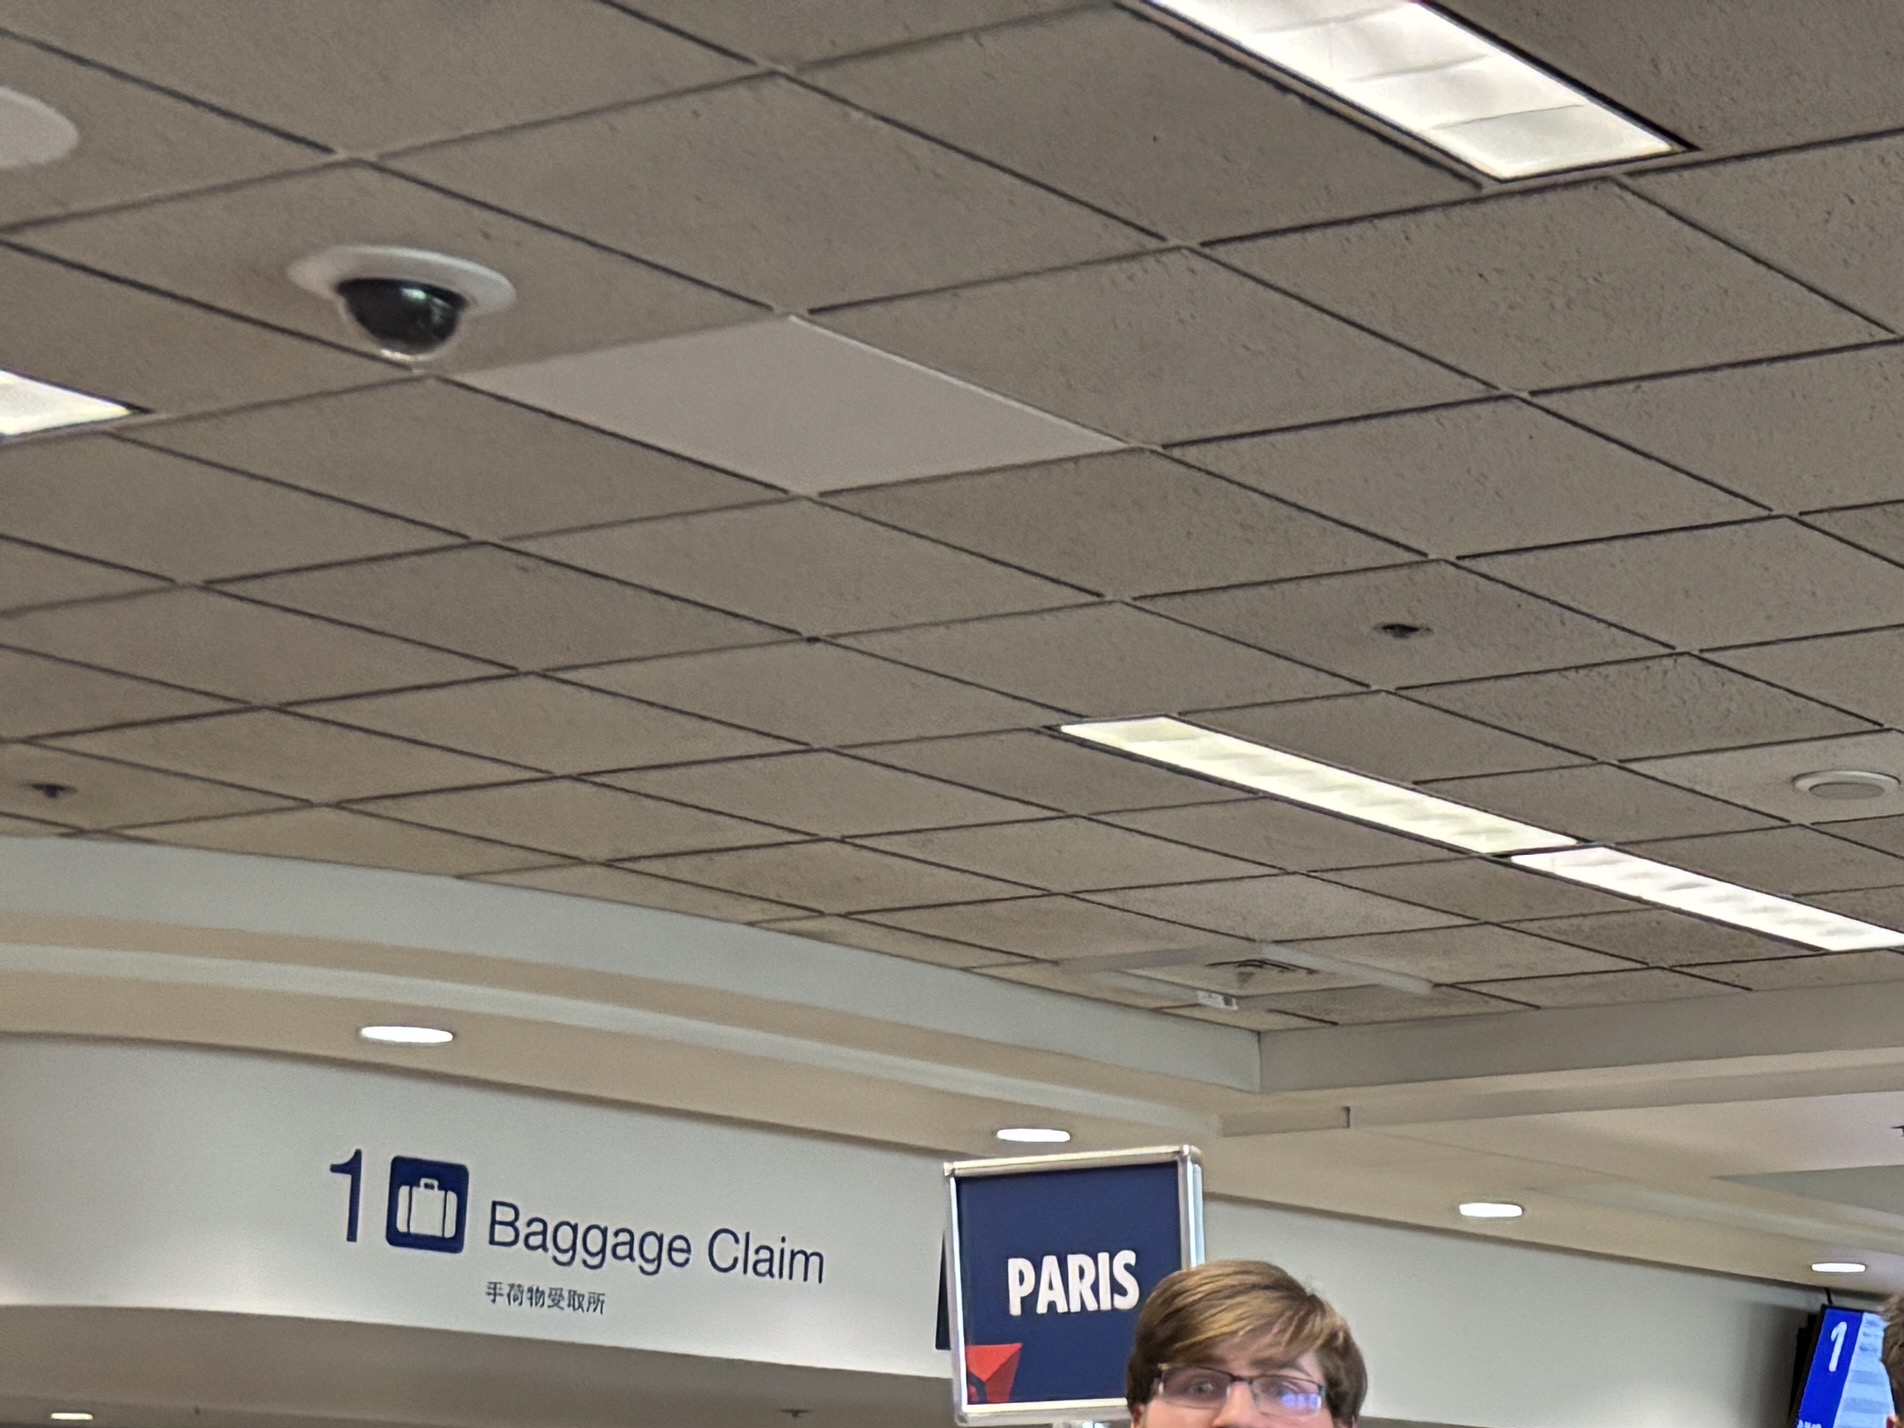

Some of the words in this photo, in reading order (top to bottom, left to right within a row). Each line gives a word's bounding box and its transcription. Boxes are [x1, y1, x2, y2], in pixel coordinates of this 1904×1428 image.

[329, 1148, 363, 1243] 1
[487, 1200, 693, 1276] Baggage
[707, 1228, 825, 1284] Claim
[486, 1280, 606, 1315] 手荷物受取所
[1007, 1249, 1140, 1316] PARIS
[1828, 1321, 1848, 1373] 1
